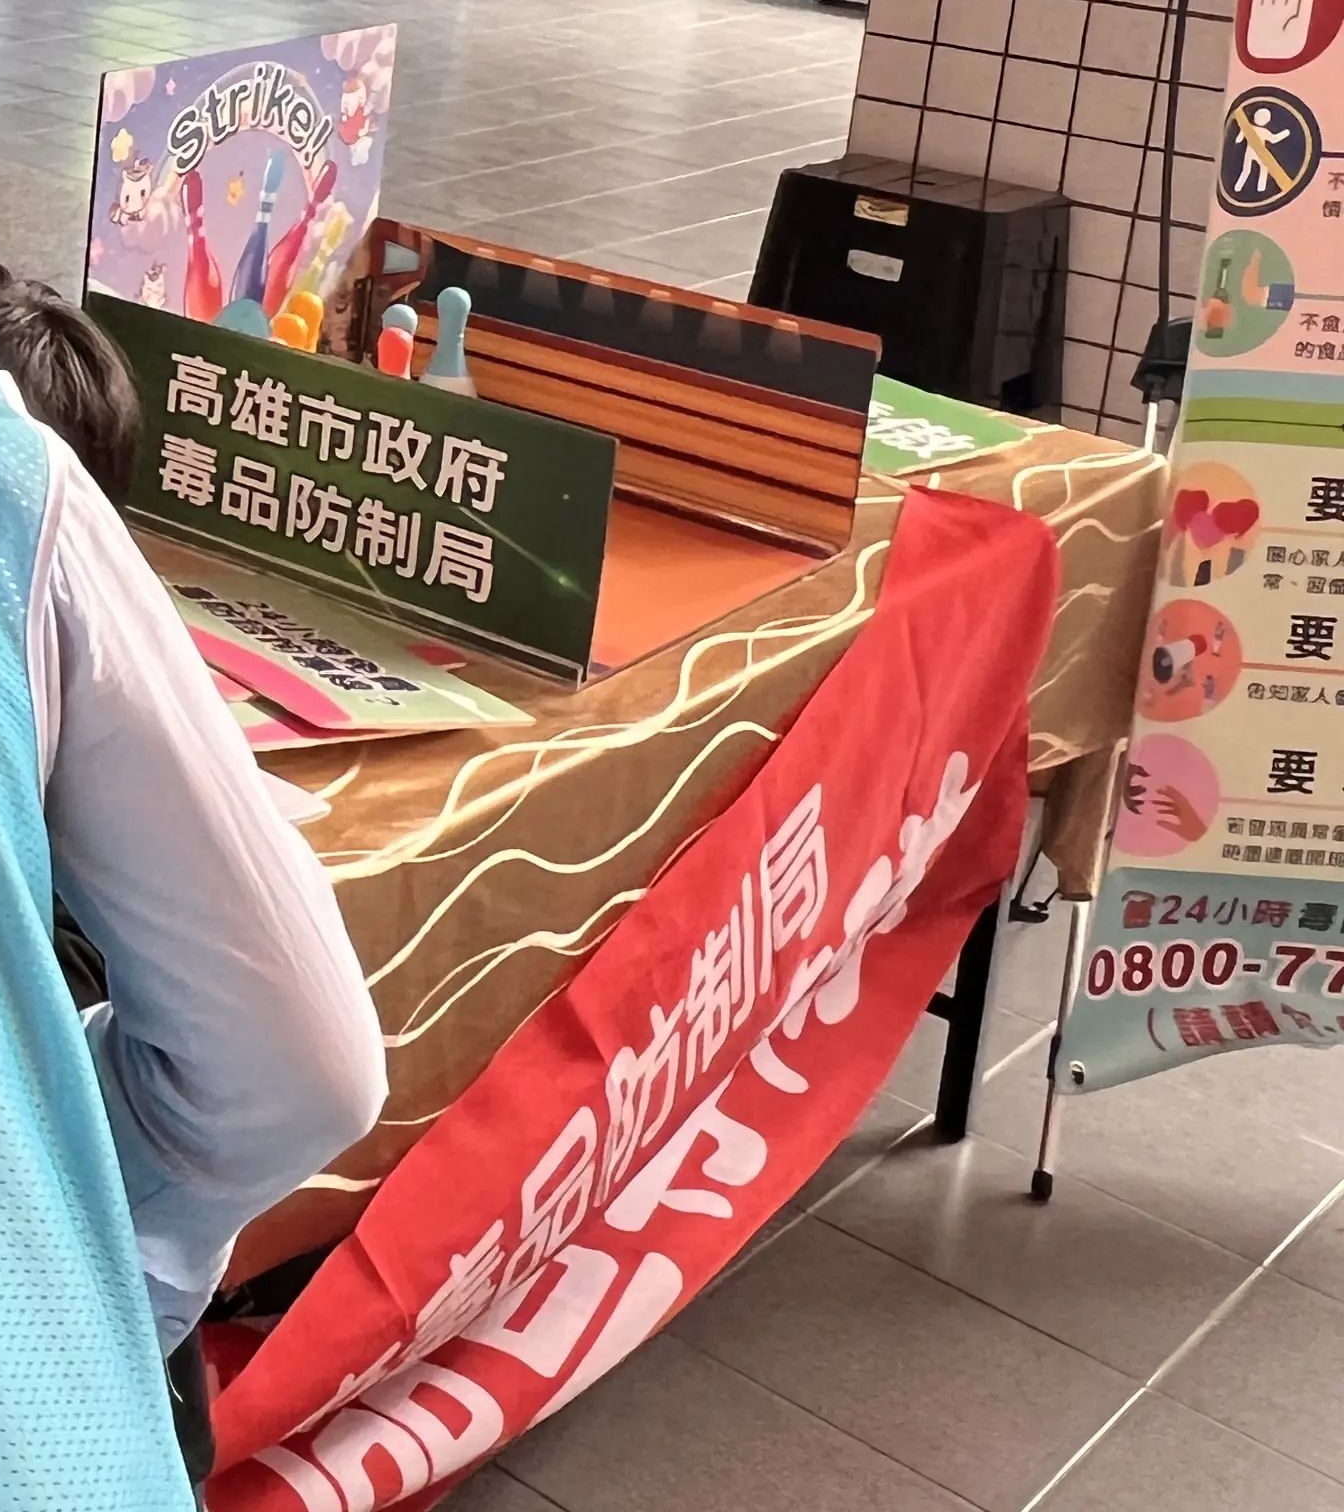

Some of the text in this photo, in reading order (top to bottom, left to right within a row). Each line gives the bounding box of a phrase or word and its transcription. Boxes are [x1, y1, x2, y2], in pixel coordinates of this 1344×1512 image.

[168, 63, 333, 173] Strike!
[166, 352, 509, 514] 高雄市政府
[158, 432, 495, 604] 毒品防制局
[1305, 477, 1344, 522] 要
[1285, 614, 1338, 661] 要
[1267, 748, 1318, 795] 要
